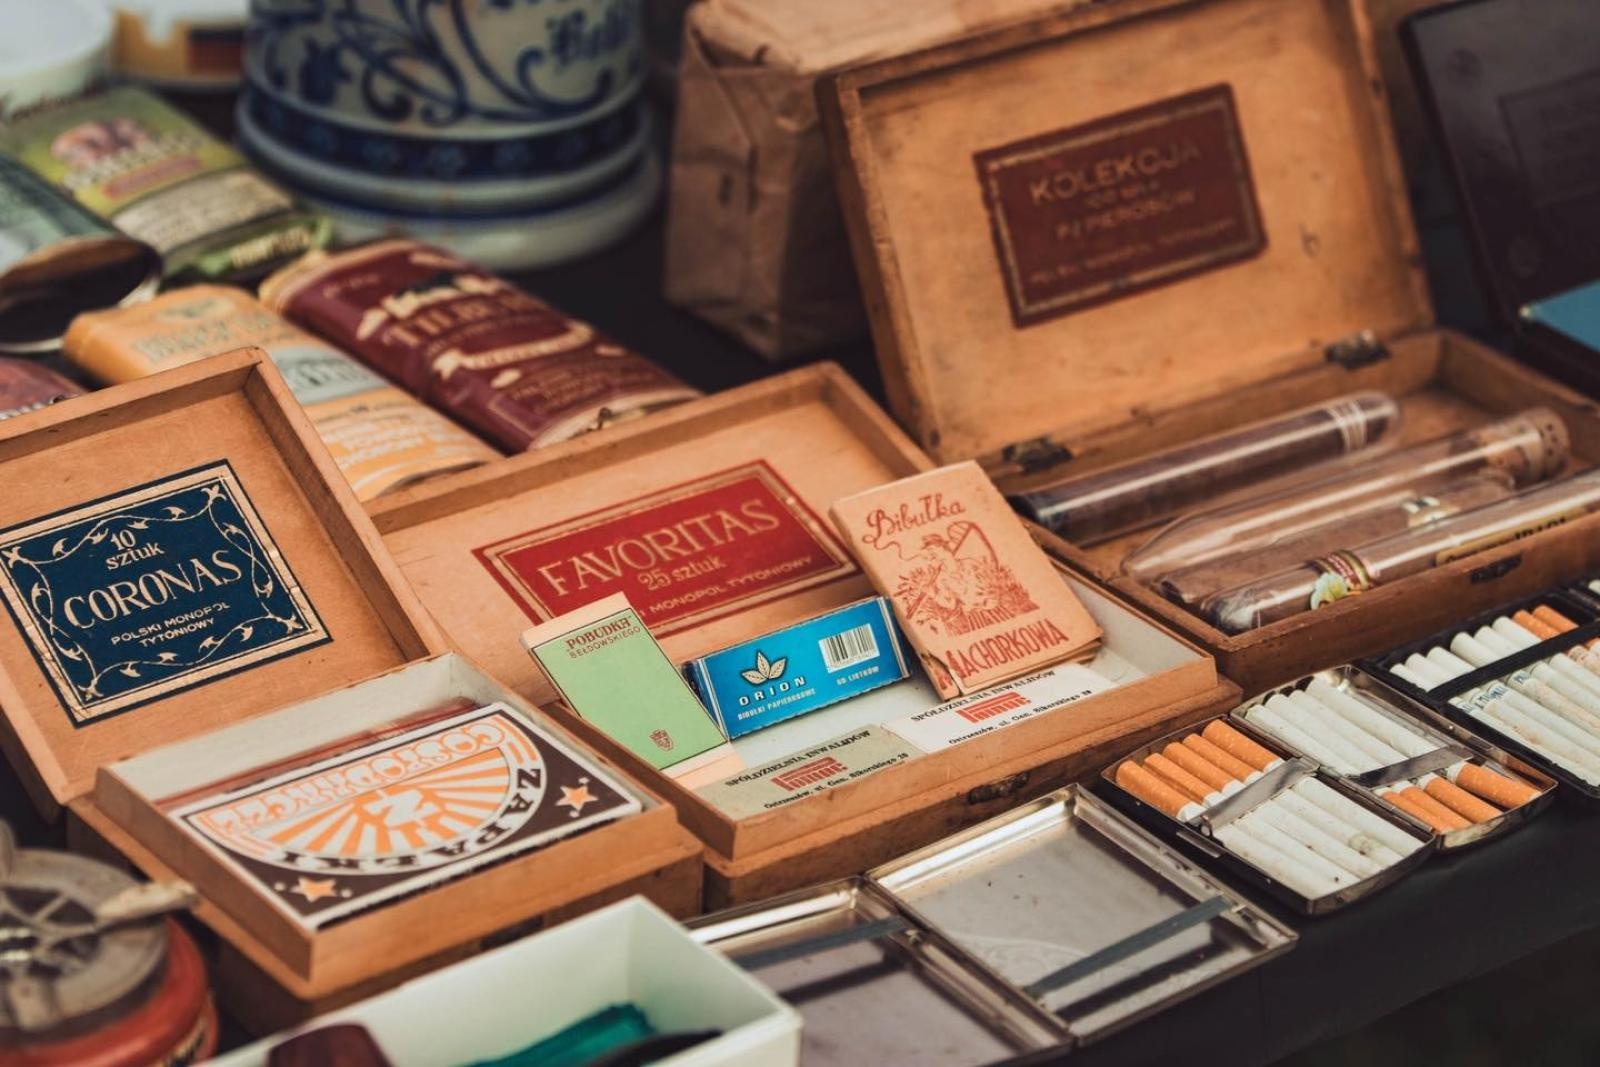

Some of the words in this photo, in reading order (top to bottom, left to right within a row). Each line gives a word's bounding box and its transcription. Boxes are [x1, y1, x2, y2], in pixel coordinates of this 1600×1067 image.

[1029, 140, 1200, 204] KOLEKCJA
[106, 541, 164, 571] sztuk
[110, 529, 136, 551] 10
[538, 499, 780, 597] FAVORITAS
[63, 550, 242, 629] CORONAS
[637, 568, 671, 591] 25
[671, 555, 727, 582] sztuk
[650, 585, 727, 613] MONOPOL
[726, 556, 812, 587] TYTONIOWY
[111, 622, 164, 645] POLSKI
[164, 601, 230, 628] MONOPOL
[139, 617, 214, 647] TYTONIOWY
[739, 676, 806, 706] ORION
